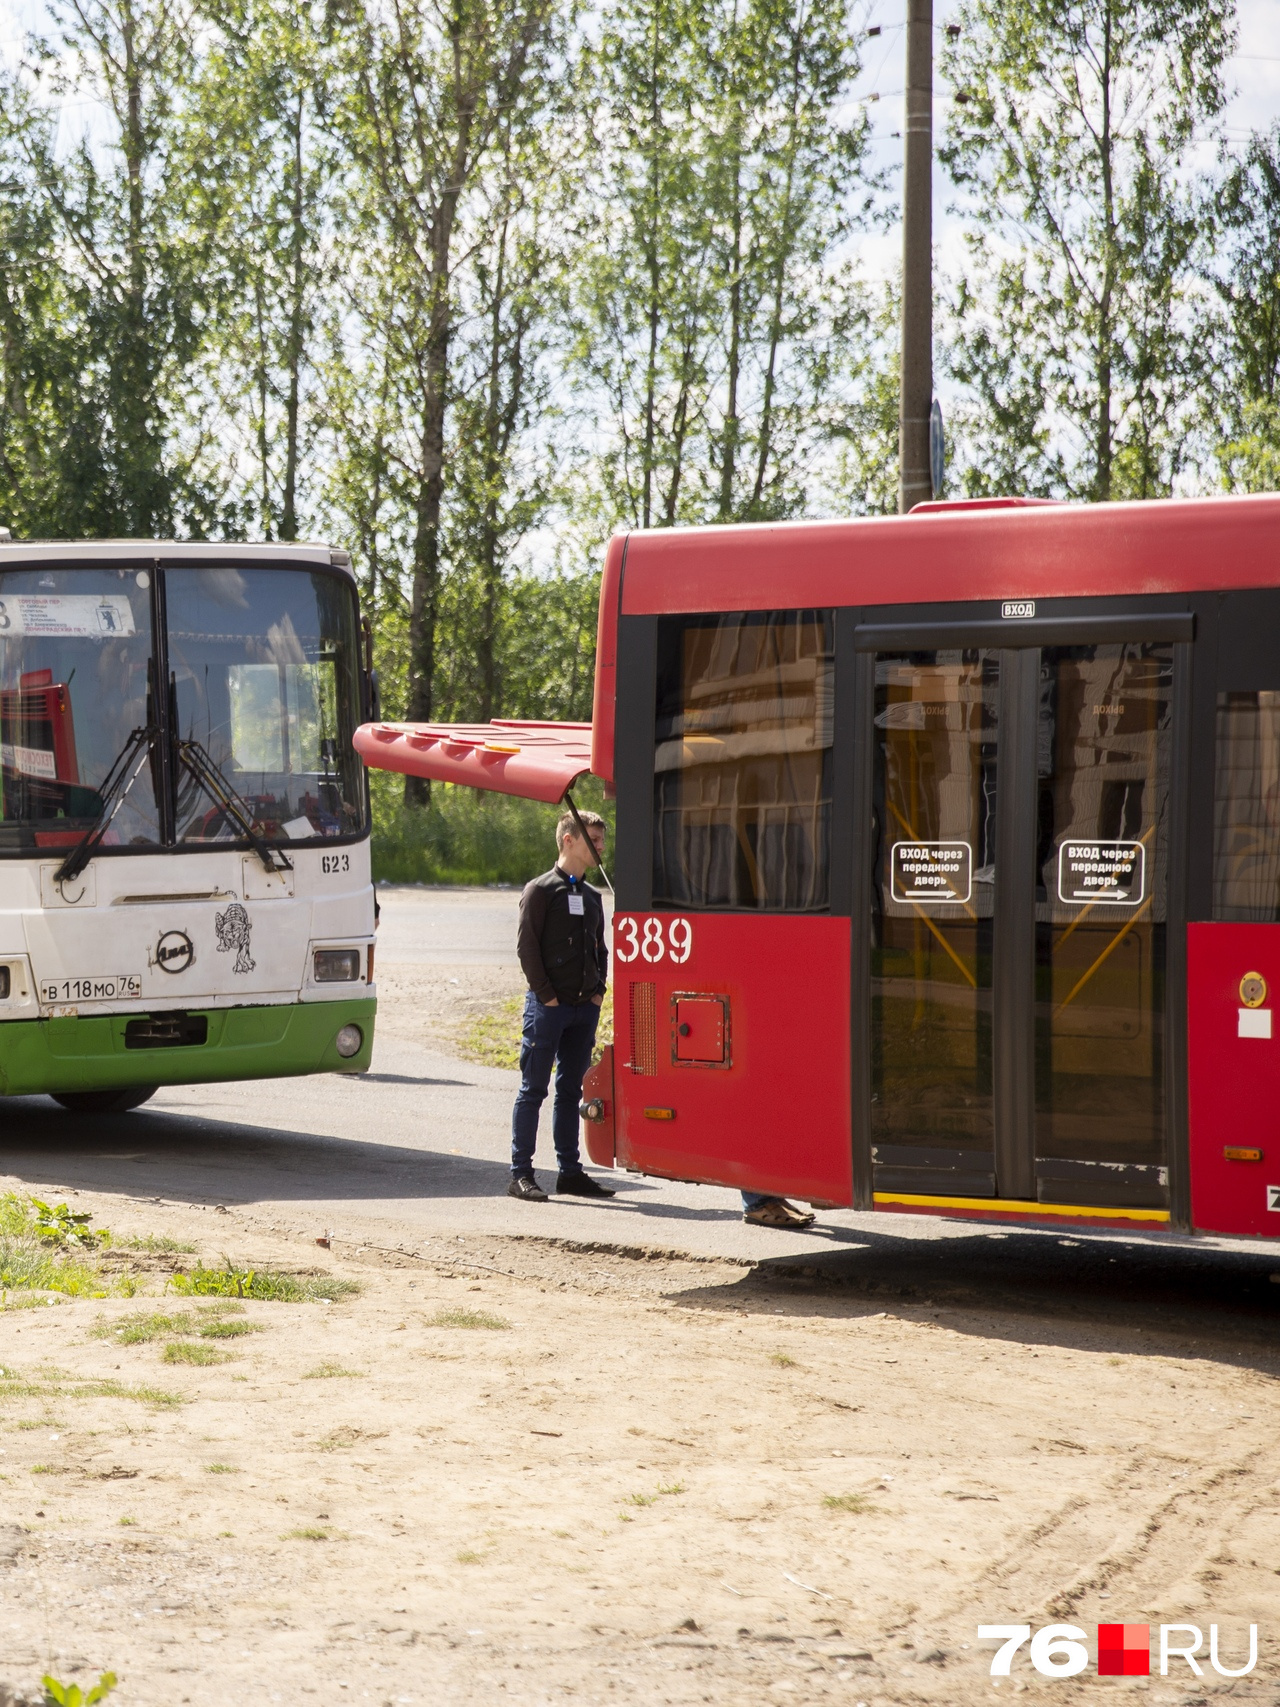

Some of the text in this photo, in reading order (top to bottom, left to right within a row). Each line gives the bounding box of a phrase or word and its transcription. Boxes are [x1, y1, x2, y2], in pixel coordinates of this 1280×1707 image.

[1004, 604, 1032, 617] ВХОД
[900, 849, 963, 861] ВХОД через
[1068, 847, 1135, 861] ВХОД через
[322, 855, 350, 873] 623
[903, 863, 959, 874] переднюю
[1071, 863, 1132, 874] переднюю
[914, 876, 947, 887] дверь
[1083, 876, 1118, 887] дверь
[616, 917, 692, 964] 389
[120, 977, 135, 991] 76
